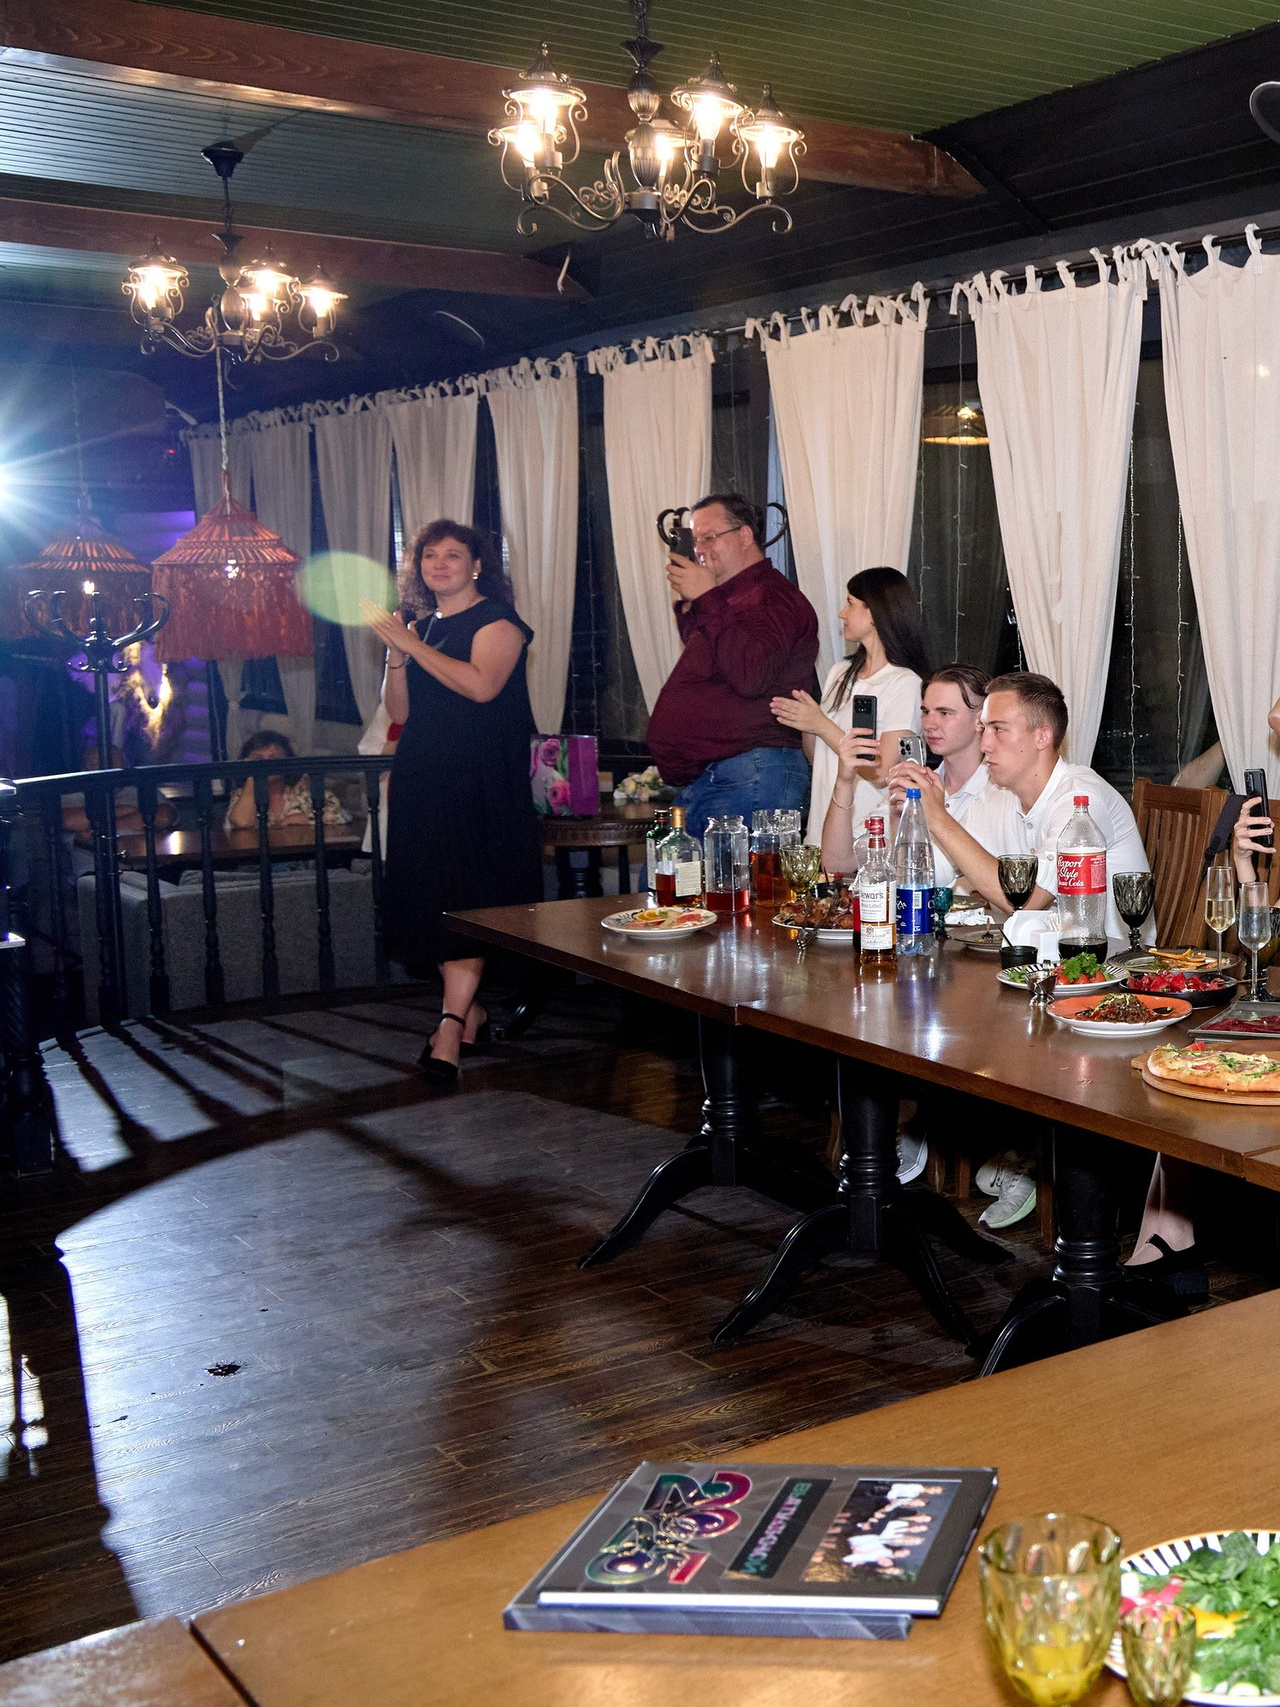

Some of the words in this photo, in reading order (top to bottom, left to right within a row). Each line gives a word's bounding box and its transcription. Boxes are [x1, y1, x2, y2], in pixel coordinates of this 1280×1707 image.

[1058, 856, 1085, 868] Export
[1060, 867, 1079, 881] Style
[1069, 878, 1084, 887] Cola
[585, 1471, 753, 1585] 2025
